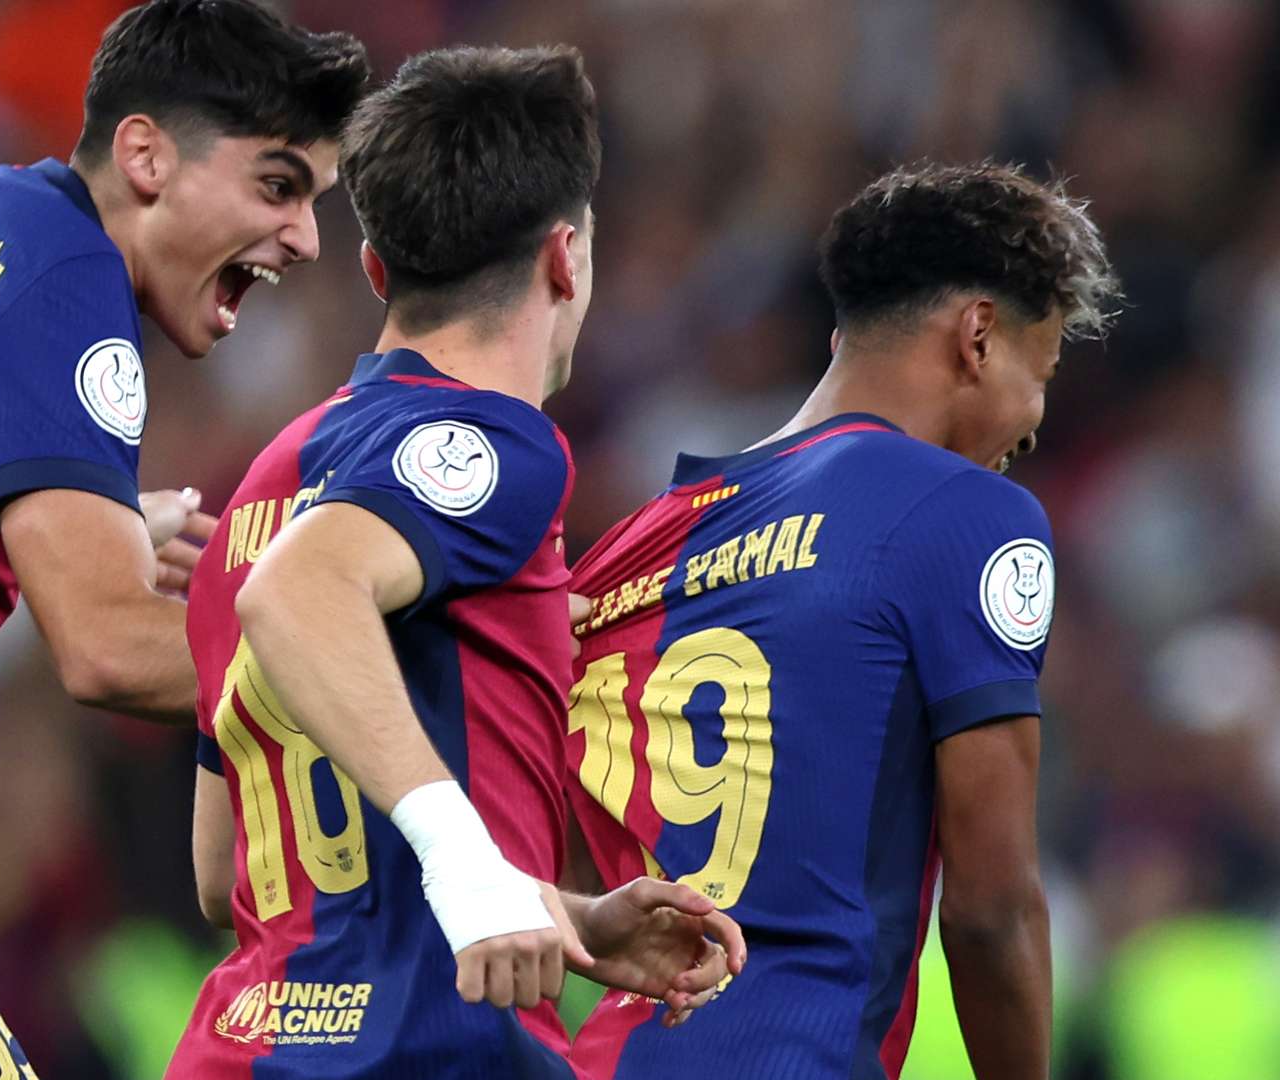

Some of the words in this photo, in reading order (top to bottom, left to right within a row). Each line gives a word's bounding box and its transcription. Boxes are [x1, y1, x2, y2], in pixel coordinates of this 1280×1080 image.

[684, 513, 825, 597] YAMAL
[568, 627, 775, 910] 19
[263, 1008, 364, 1034] ACNUR
[269, 981, 373, 1009] UNHCR
